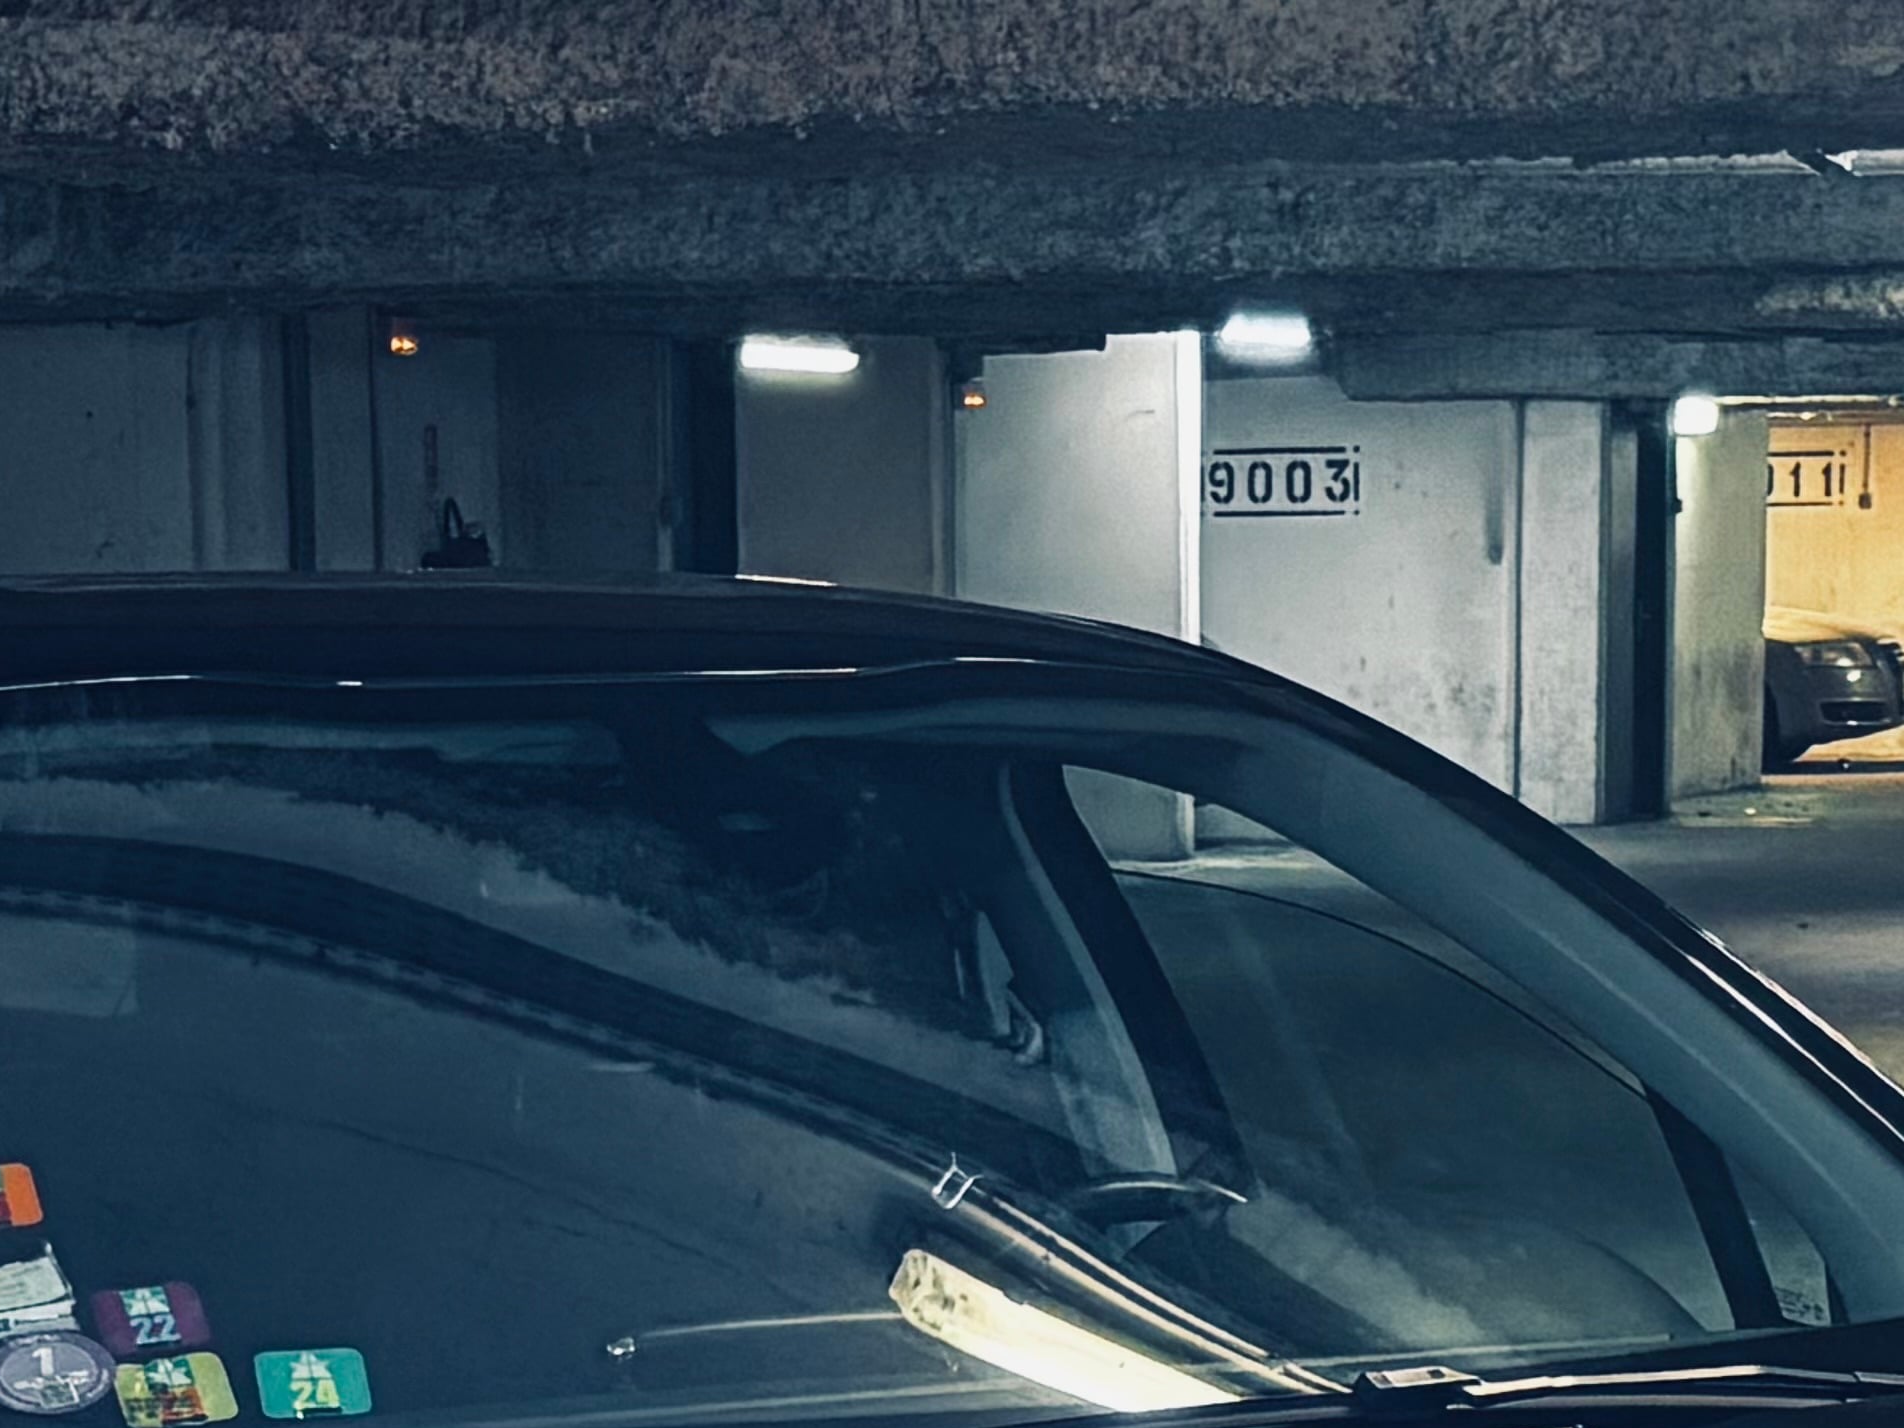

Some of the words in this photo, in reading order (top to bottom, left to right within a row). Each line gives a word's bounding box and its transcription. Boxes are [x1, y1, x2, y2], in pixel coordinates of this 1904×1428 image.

[1208, 459, 1351, 504] 9003
[129, 1314, 182, 1345] 22
[31, 1347, 55, 1377] 1
